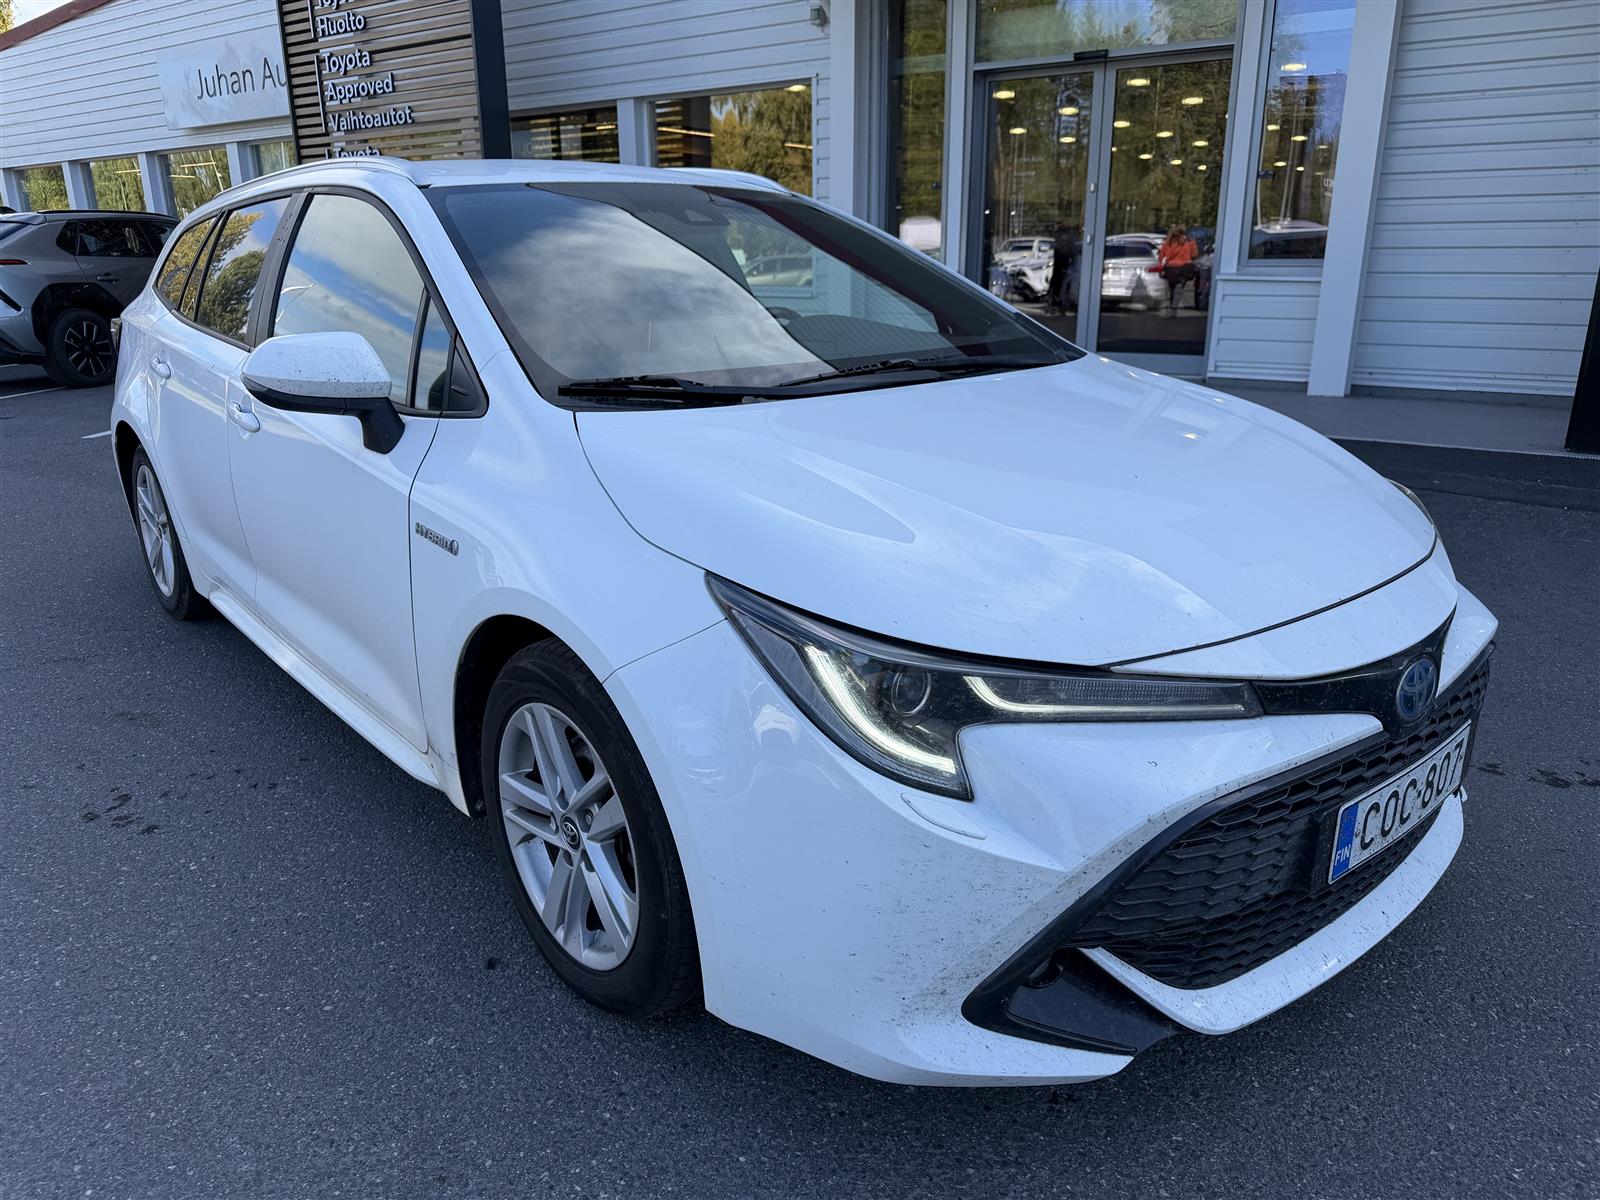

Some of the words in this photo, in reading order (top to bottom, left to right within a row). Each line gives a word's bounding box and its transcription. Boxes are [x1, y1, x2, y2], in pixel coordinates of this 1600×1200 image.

[317, 11, 365, 37] Huolto
[322, 48, 370, 75] Toyota
[197, 64, 255, 100] Juhan
[326, 72, 393, 102] Approved
[328, 106, 413, 132] Vaihtoautot
[415, 521, 452, 553] HYBRID
[1361, 737, 1465, 850] COC-807
[1334, 843, 1352, 866] FIN
